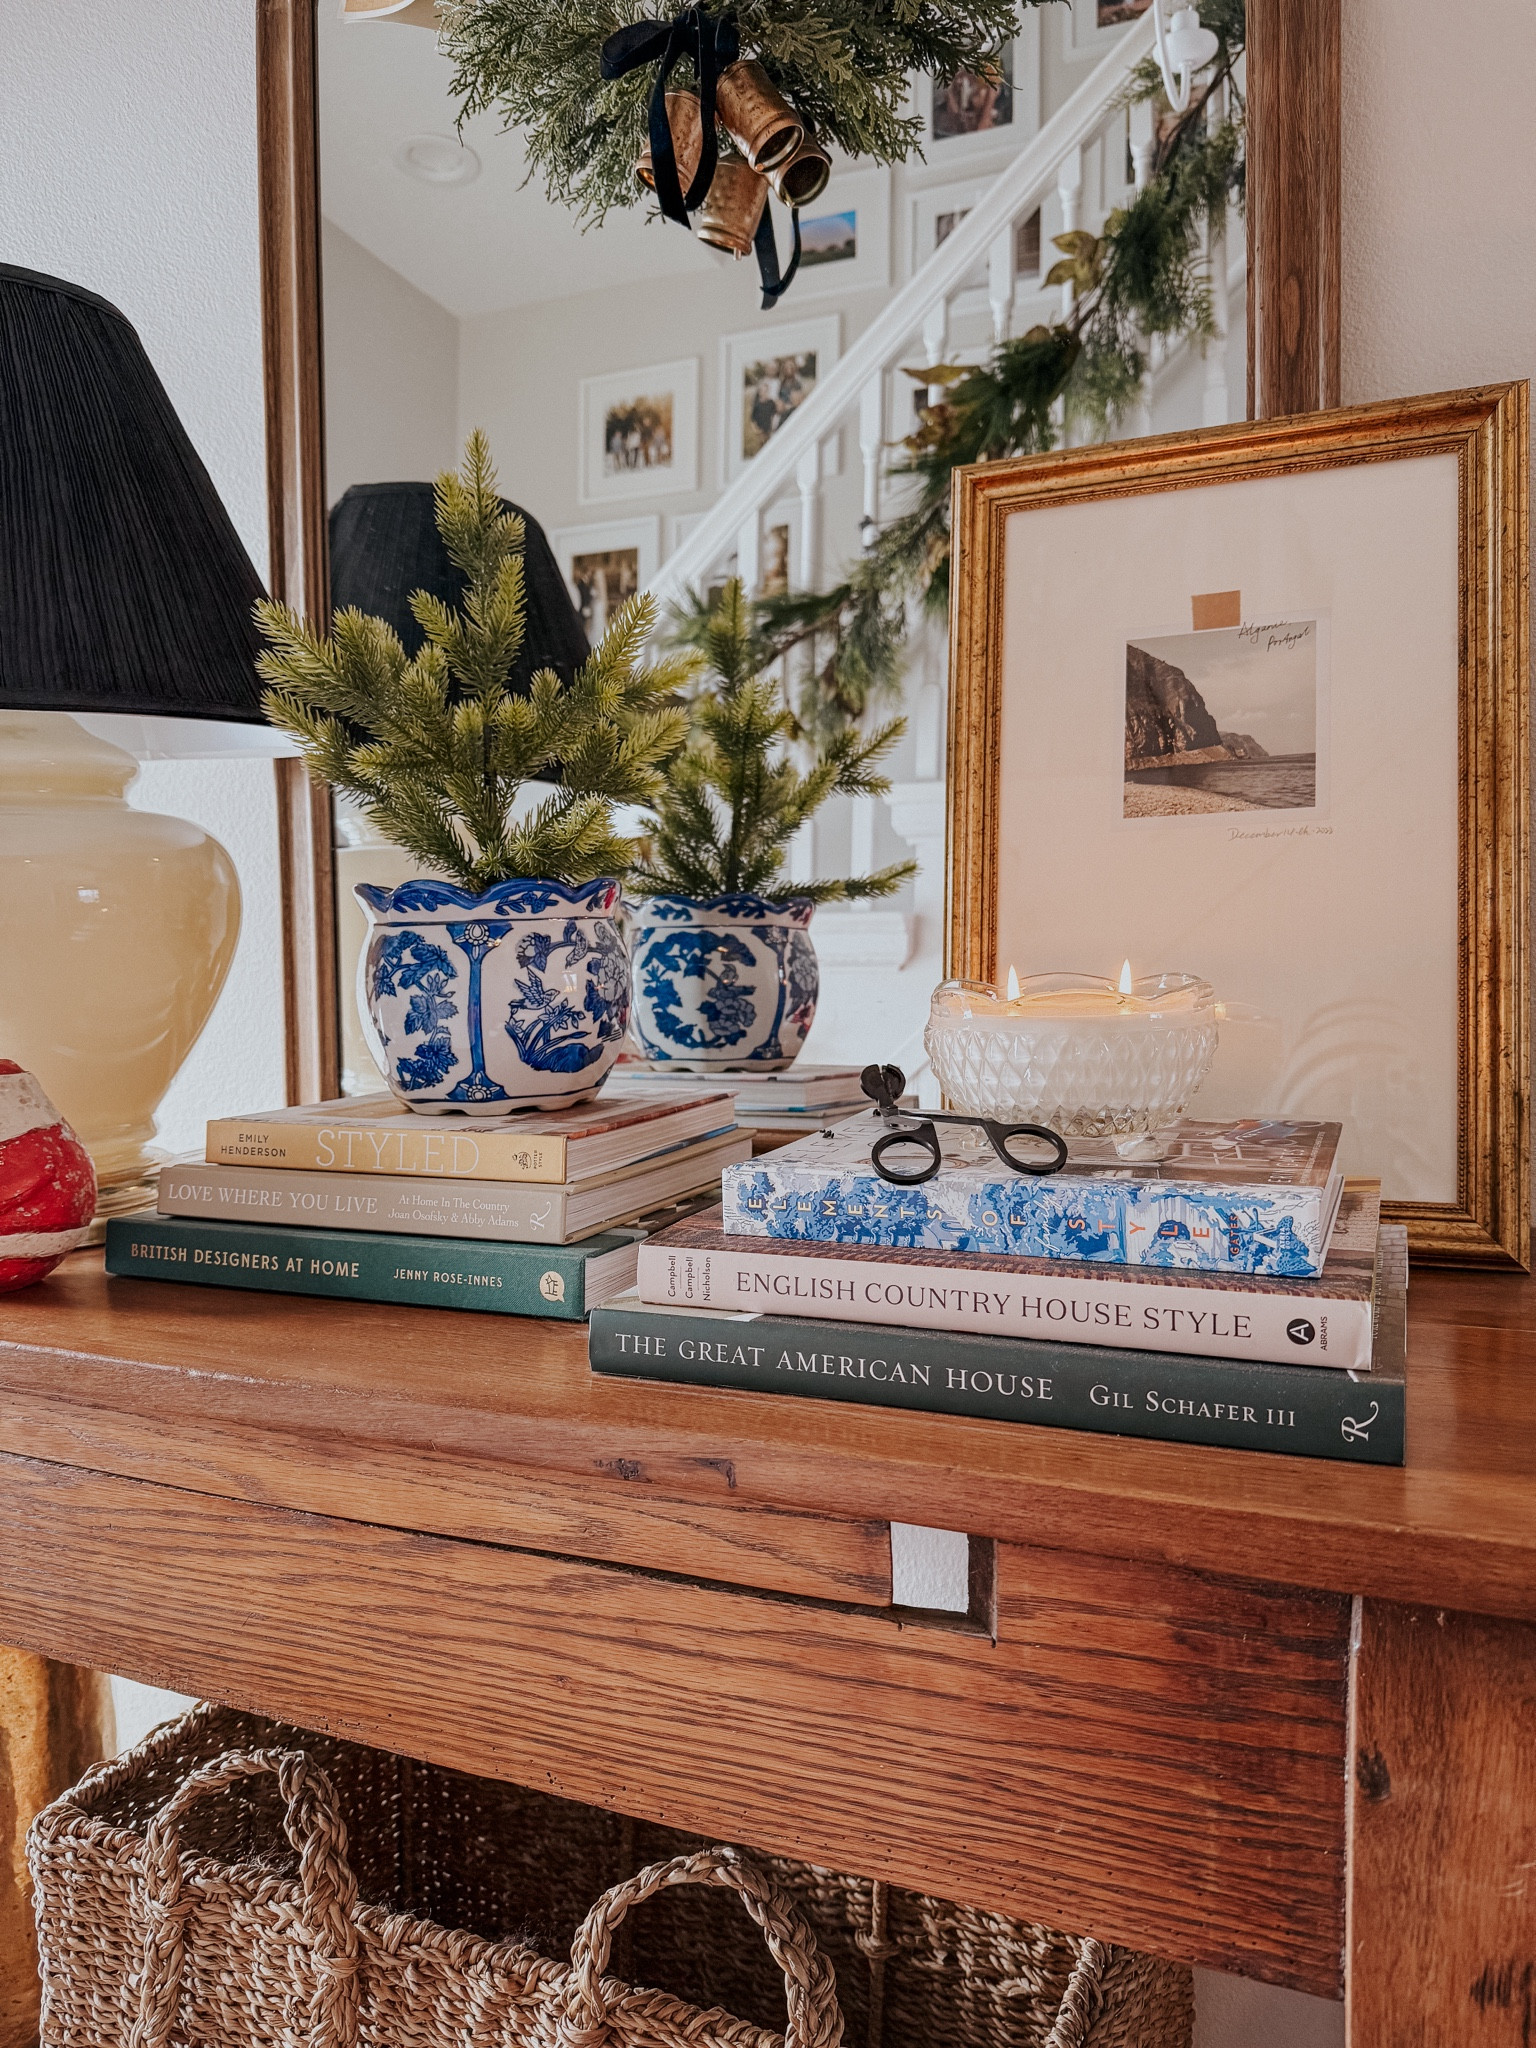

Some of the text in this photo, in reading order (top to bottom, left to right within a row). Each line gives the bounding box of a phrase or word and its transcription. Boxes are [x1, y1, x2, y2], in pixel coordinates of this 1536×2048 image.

[221, 1145, 287, 1158] HENDERSON
[238, 1133, 269, 1144] EMILY
[315, 1129, 480, 1175] STYLED
[168, 1183, 379, 1214] LOVE WHERE YOU LIVE
[388, 1208, 520, 1228] Joan Osofsky & Abby Adams
[398, 1194, 510, 1214] At Home In The Country
[748, 1197, 943, 1221] ELEMENTS
[982, 1209, 1027, 1227] OF
[1067, 1218, 1211, 1240] STYLE
[1230, 1215, 1240, 1255] GATES
[131, 1243, 360, 1278] BRITISH DESIGNERS AT HOME
[393, 1268, 504, 1288] JENNY ROSE-INNES
[668, 1255, 677, 1297] Campbell
[685, 1256, 695, 1299] Campbell
[702, 1256, 711, 1301] Nicholson
[736, 1271, 1252, 1339] ENGLISH COUNTRY HOUSE STYLE
[1320, 1315, 1328, 1352] ABRAMS
[615, 1332, 1053, 1400] THE GREAT AMERICAN HOUSE
[1089, 1384, 1296, 1427] GIL SCHAFER III
